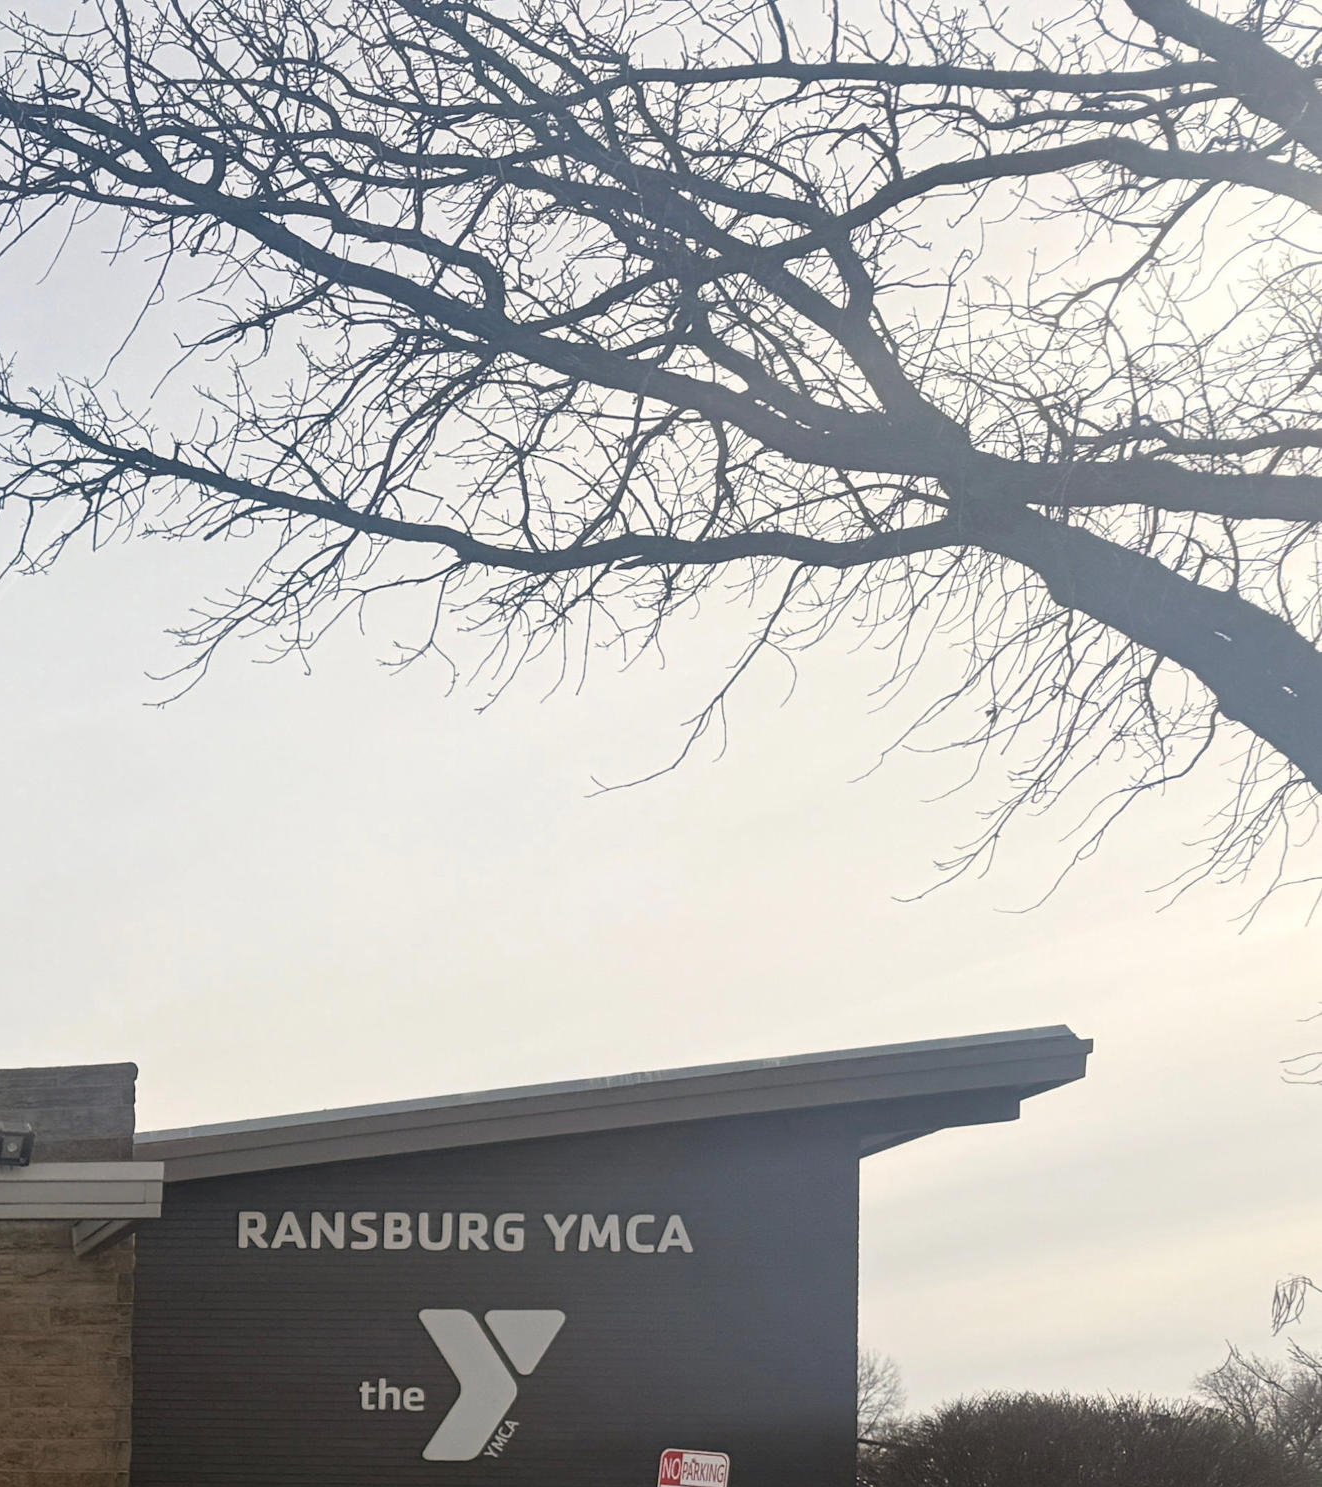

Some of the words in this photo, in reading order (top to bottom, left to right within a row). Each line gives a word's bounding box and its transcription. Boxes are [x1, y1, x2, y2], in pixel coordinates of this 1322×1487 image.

[237, 1210, 526, 1253] RANSBURG
[543, 1213, 694, 1254] YMCA
[359, 1378, 425, 1412] the
[483, 1420, 520, 1458] YMCA
[661, 1457, 681, 1480] NO
[682, 1461, 725, 1483] PARKING
